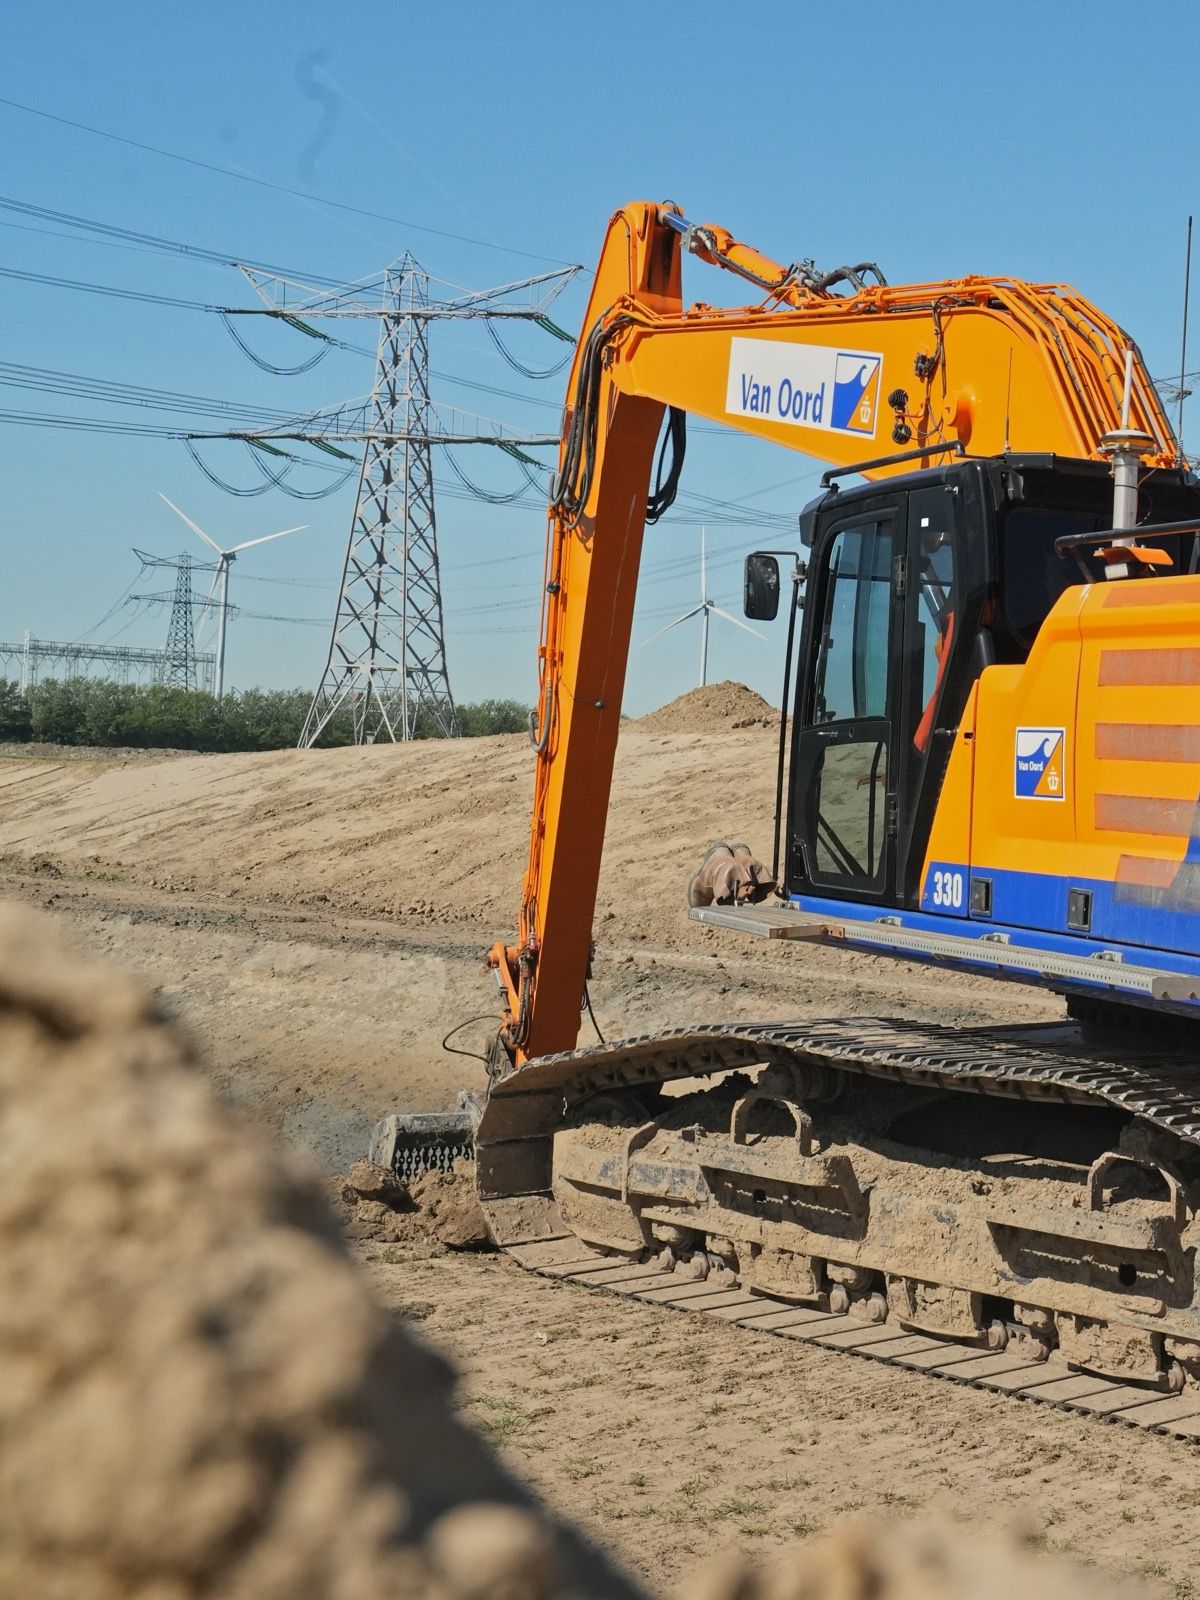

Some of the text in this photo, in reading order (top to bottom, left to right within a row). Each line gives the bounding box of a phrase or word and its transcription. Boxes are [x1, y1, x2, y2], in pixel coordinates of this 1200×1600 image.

[742, 373, 825, 423] Van Oord
[1018, 760, 1044, 772] Van Oord
[933, 871, 962, 907] 330
